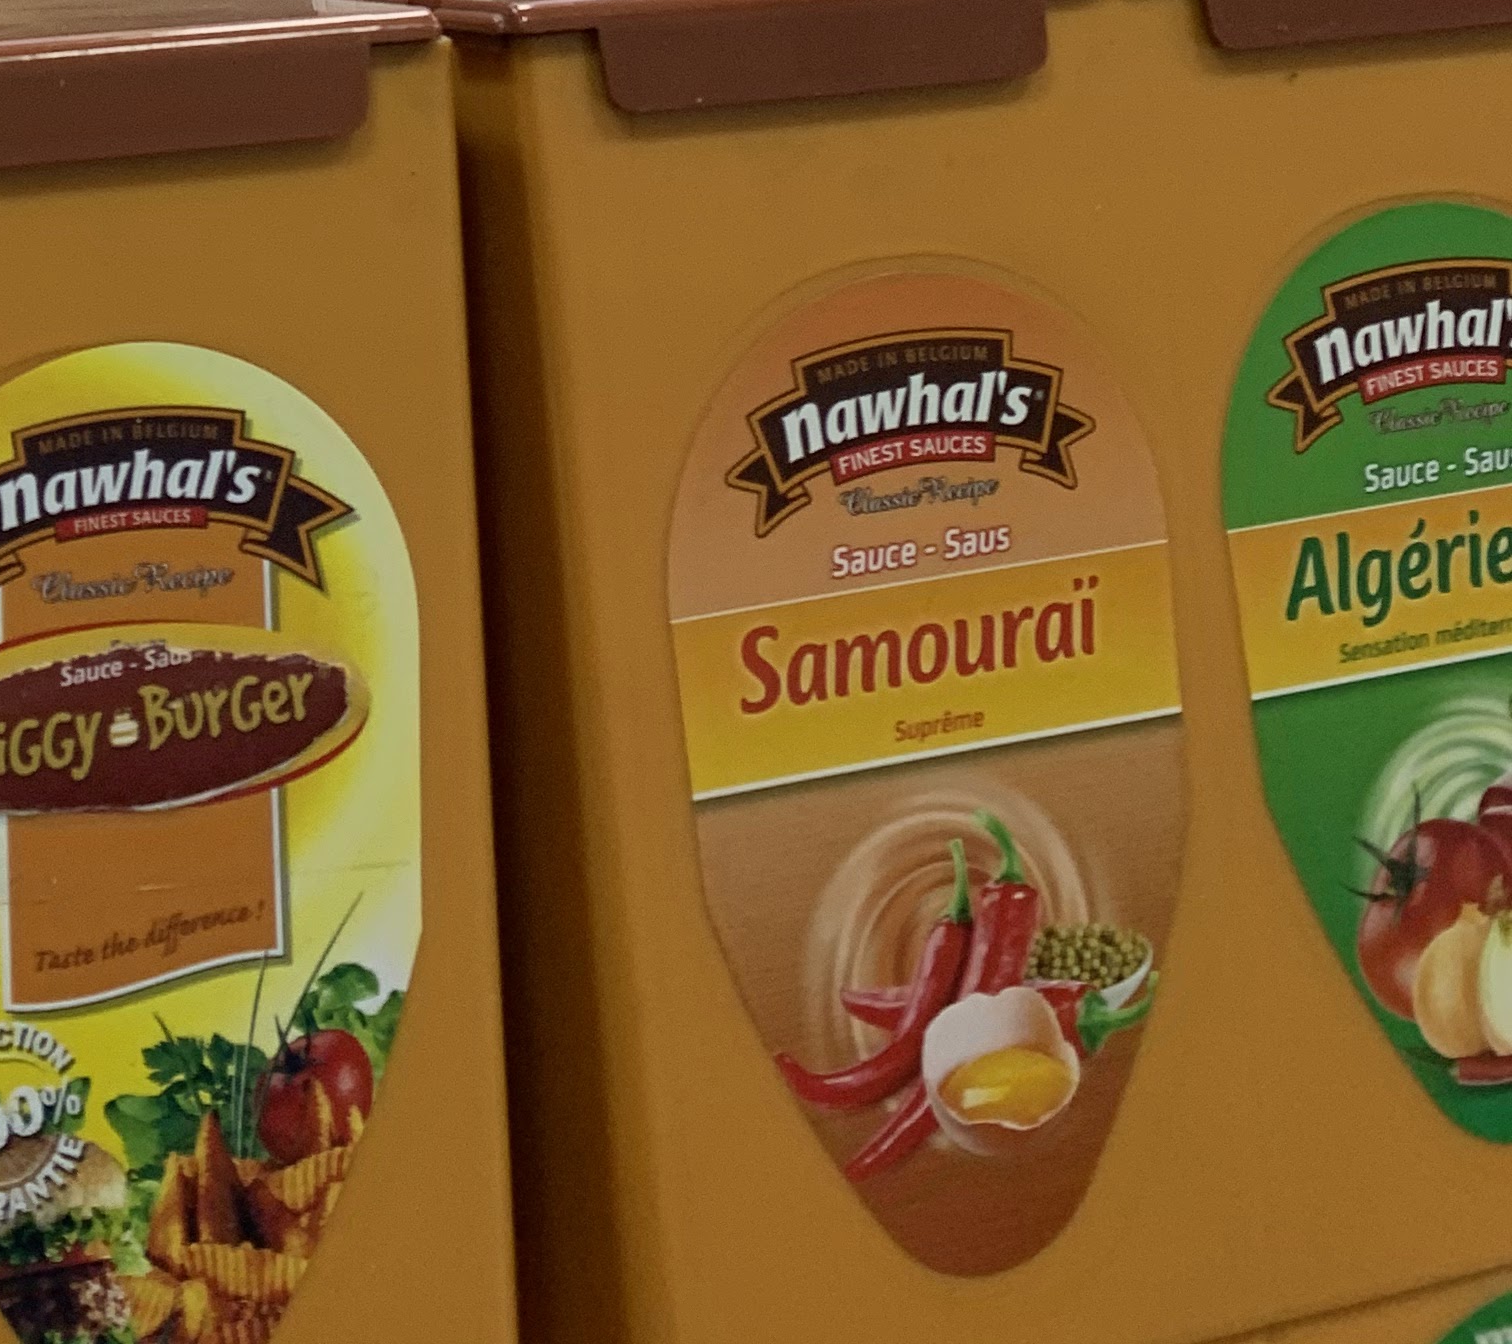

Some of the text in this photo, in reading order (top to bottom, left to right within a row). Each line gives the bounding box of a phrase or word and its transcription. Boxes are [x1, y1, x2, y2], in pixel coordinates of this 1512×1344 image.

[1314, 298, 1512, 385] nawhal'
[1365, 360, 1499, 396] FINEST SAUCES
[781, 370, 1033, 464] nawhal's
[838, 435, 987, 475] FINEST SAUCES
[1364, 447, 1512, 493] Sauce Sau
[73, 508, 190, 535] FINEST SAUCES
[831, 525, 1012, 579] Sauce Saus
[740, 575, 1100, 715] Samouraï
[59, 659, 123, 688] Sauce
[894, 710, 985, 742] Suprême
